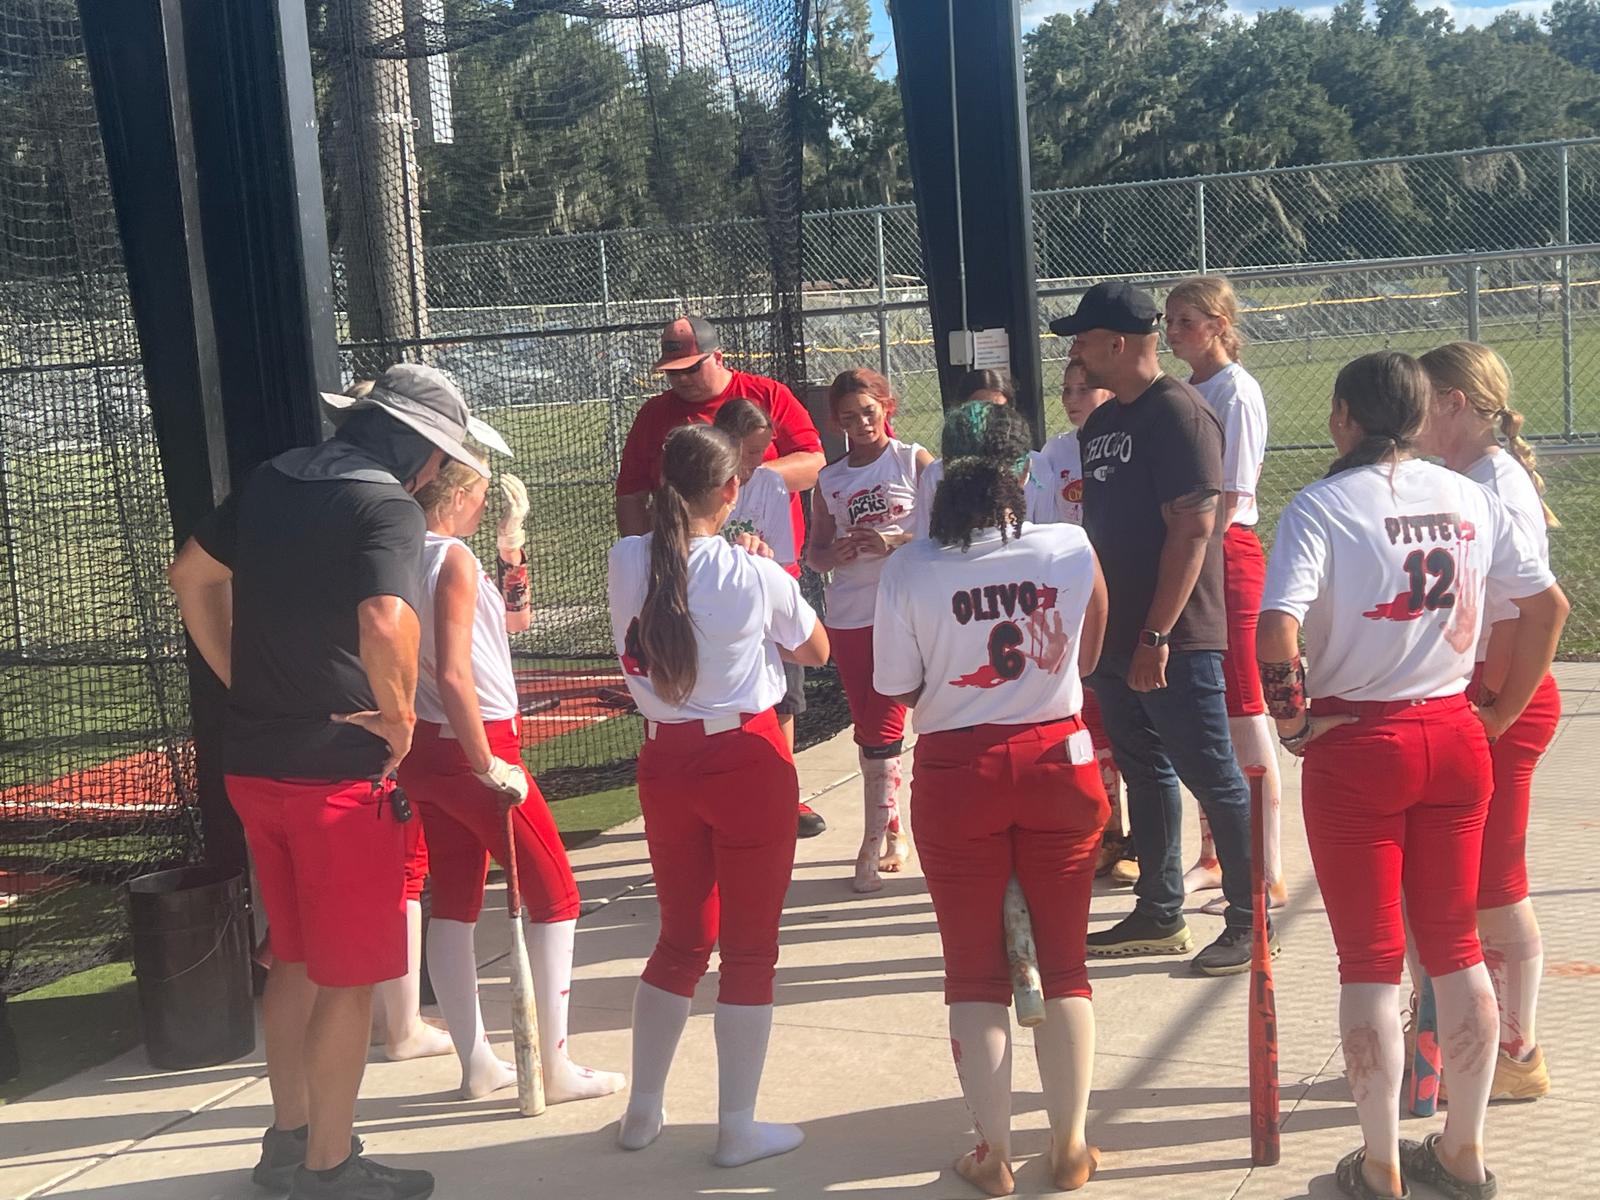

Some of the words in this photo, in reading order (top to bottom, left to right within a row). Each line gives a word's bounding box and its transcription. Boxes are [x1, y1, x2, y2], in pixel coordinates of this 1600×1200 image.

[848, 499, 887, 525] JACKS
[952, 581, 1038, 625] OLIVO
[1403, 547, 1455, 611] 12
[988, 621, 1026, 680] 6
